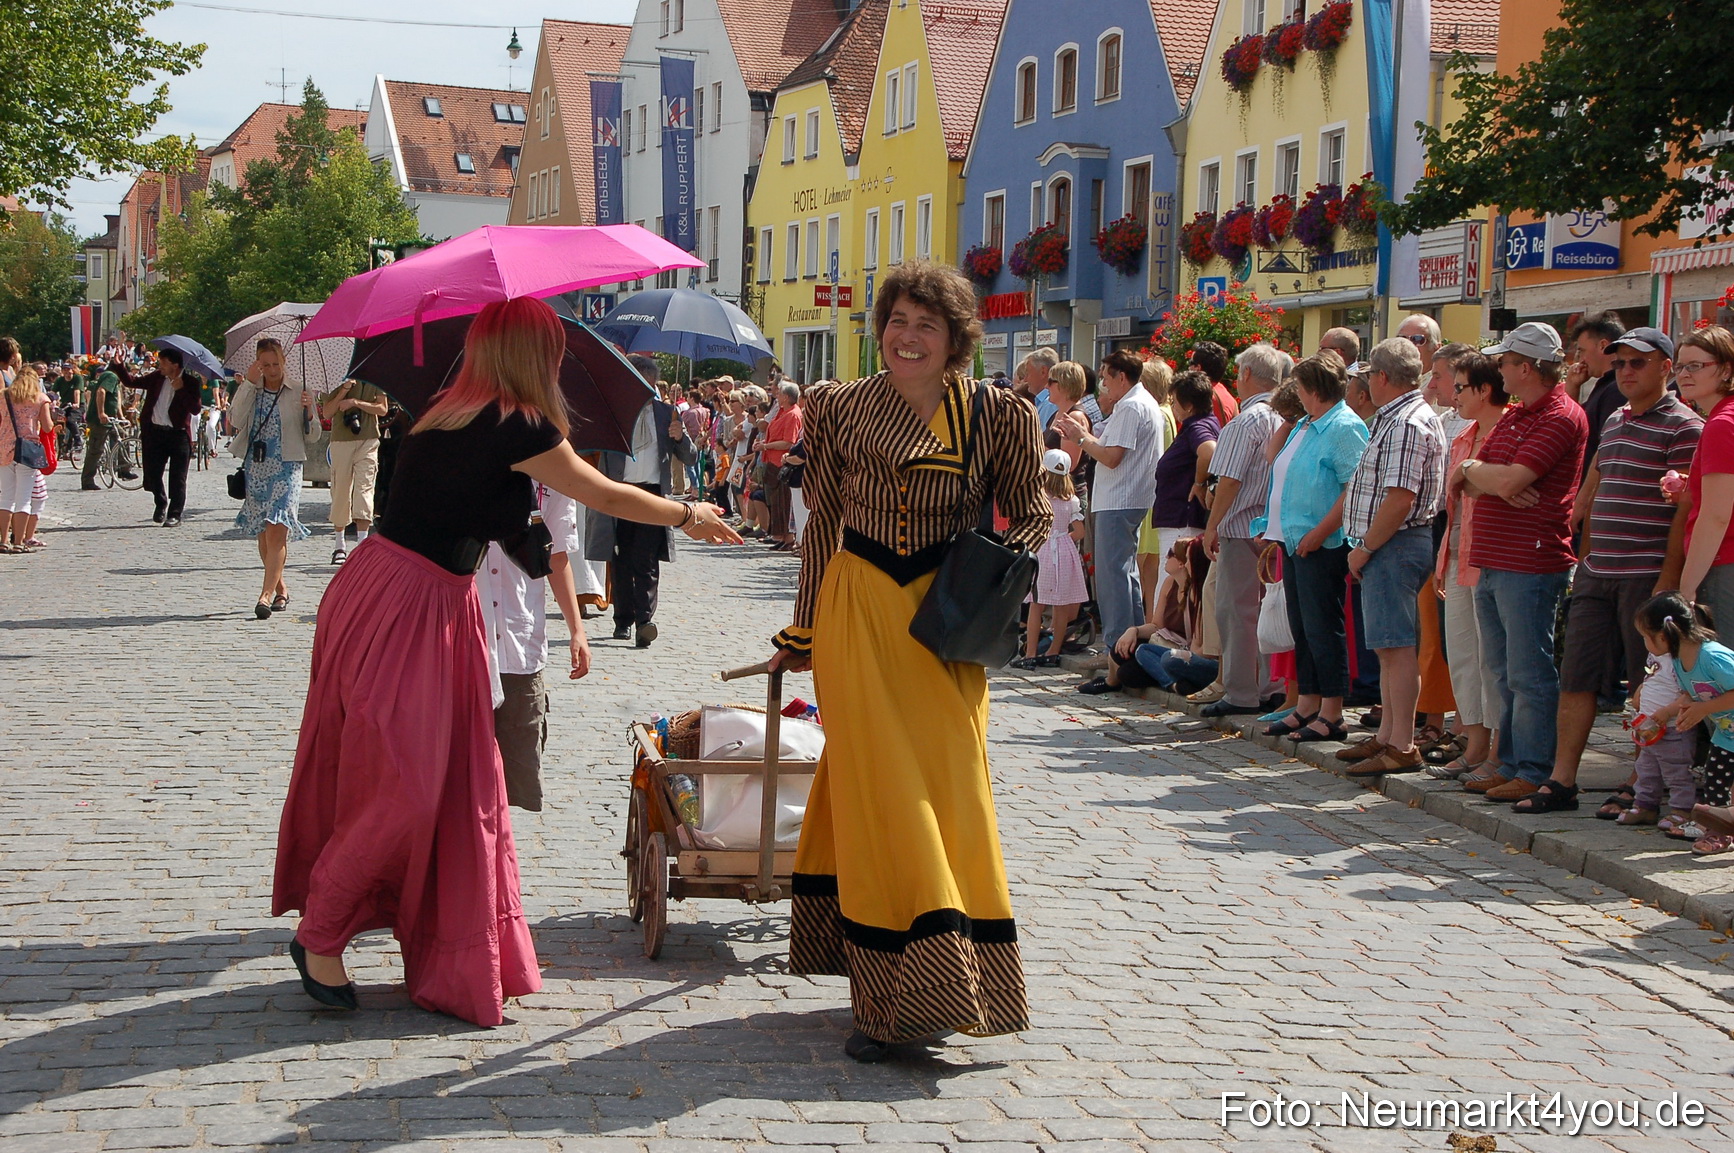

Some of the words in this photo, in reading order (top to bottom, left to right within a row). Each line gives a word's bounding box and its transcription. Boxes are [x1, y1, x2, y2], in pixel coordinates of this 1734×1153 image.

[677, 135, 688, 205] RUPPERT
[793, 188, 818, 213] HOTEL
[824, 184, 852, 205] Lehmeier
[678, 207, 688, 236] K&L
[1566, 211, 1608, 232] DER
[1155, 213, 1170, 290] WITTL
[1506, 233, 1527, 262] DER
[1532, 236, 1545, 253] Re
[1555, 253, 1615, 265] Reisebüro
[832, 255, 838, 279] P
[1466, 224, 1478, 297] KINO
[1431, 271, 1459, 288] POTTER
[816, 291, 851, 301] WISSACH
[1203, 281, 1220, 303] P
[788, 305, 822, 322] Restaurant
